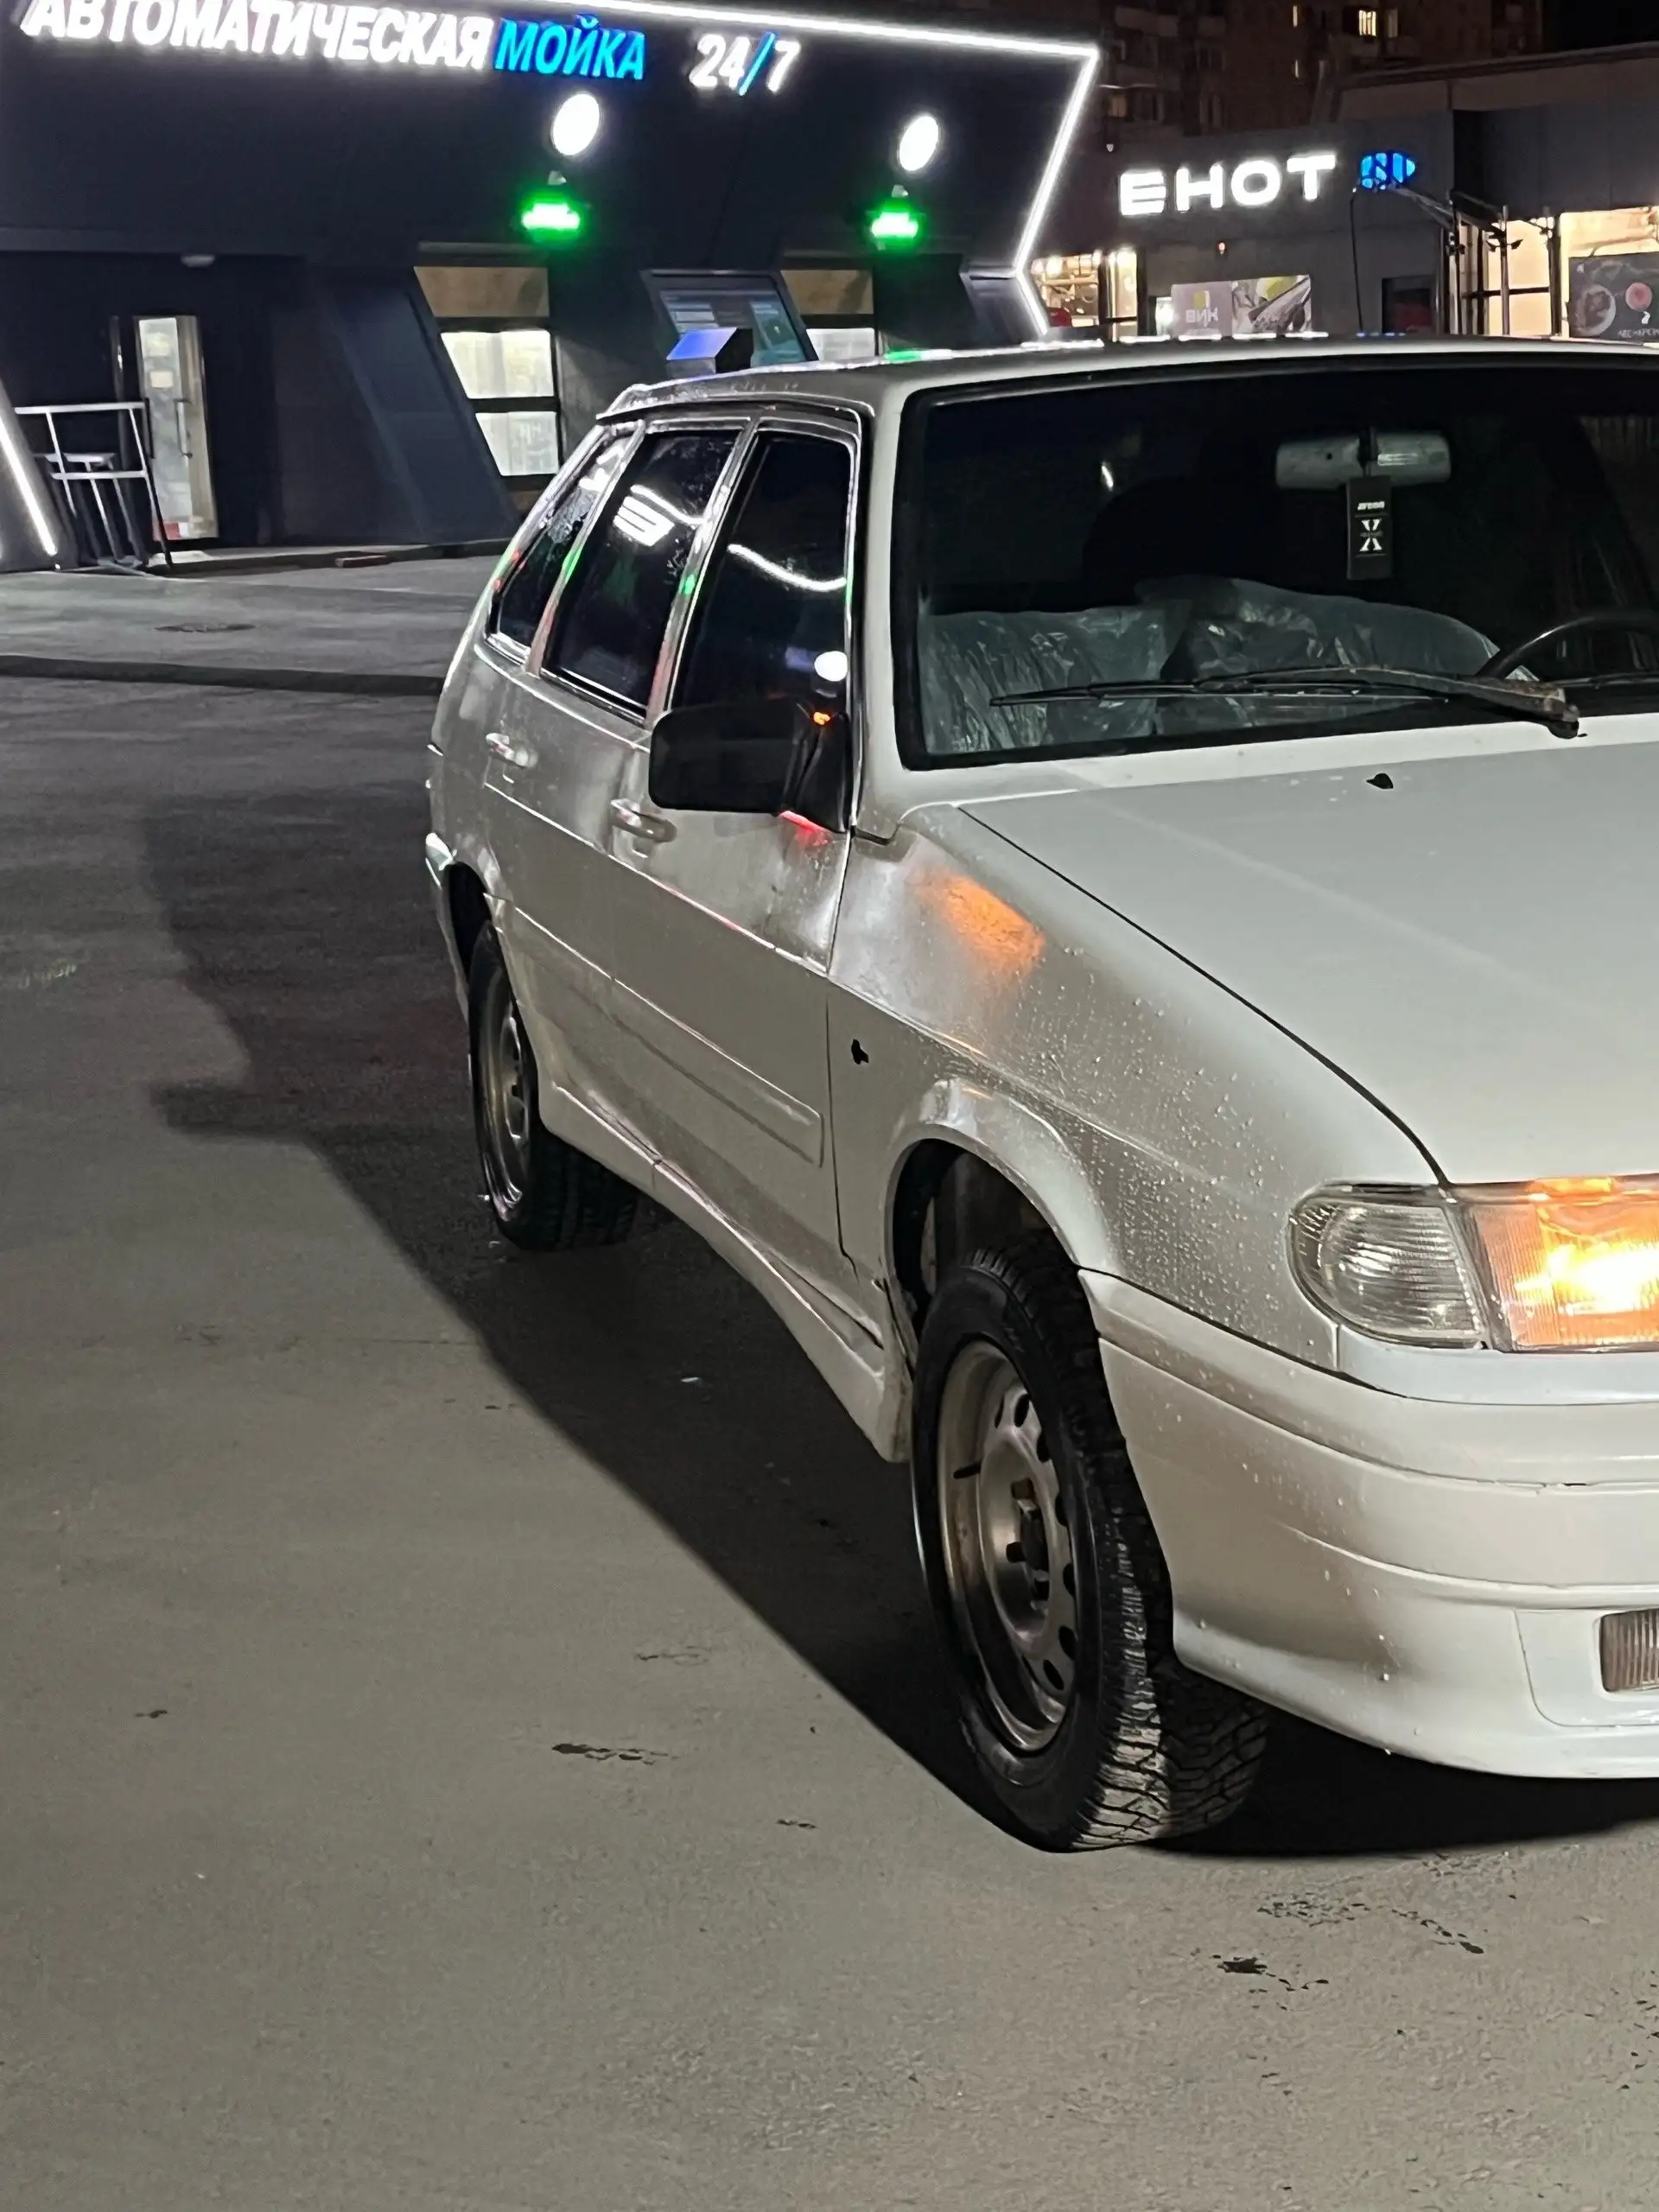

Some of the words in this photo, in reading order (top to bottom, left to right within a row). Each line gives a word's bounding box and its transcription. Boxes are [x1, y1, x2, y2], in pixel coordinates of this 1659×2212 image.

[20, 0, 494, 71] АВТОМАТИЧЕСКАЯ
[494, 14, 645, 80] МОЙКА
[690, 31, 801, 96] 24/7
[1120, 155, 1337, 216] ЕНОТ
